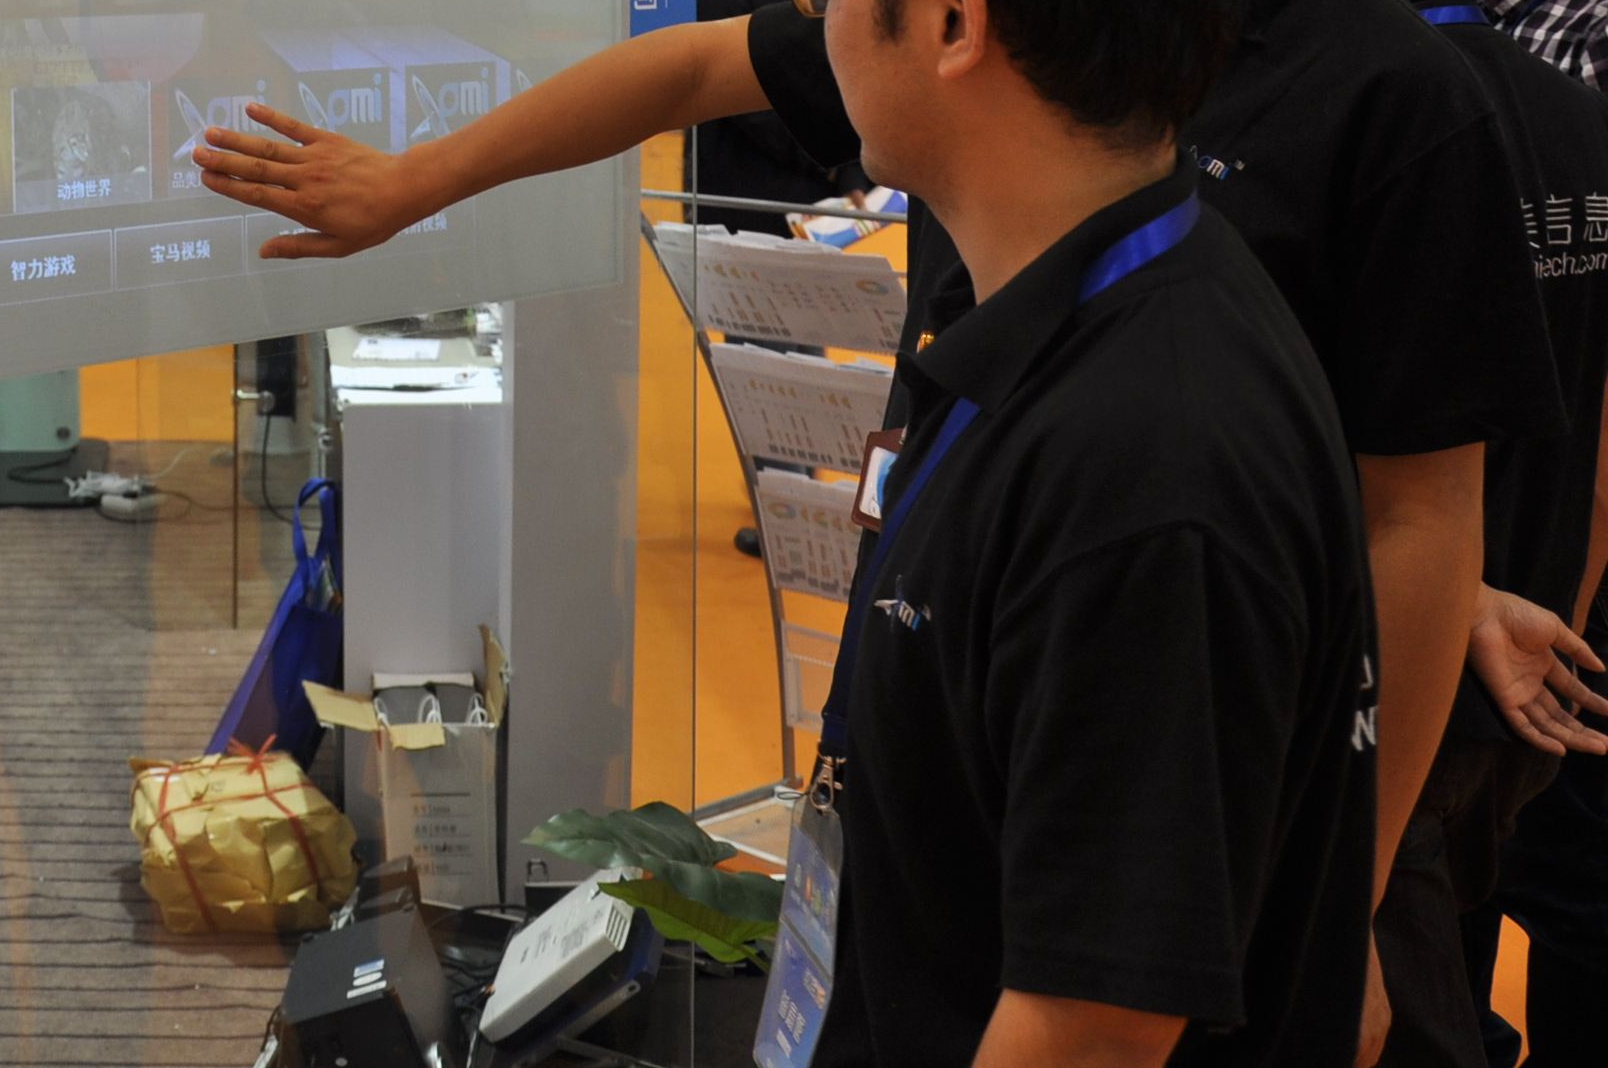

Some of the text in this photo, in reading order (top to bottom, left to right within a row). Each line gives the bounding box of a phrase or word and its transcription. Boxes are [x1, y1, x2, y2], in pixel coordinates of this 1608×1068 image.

[327, 72, 383, 131] pmi
[439, 67, 490, 135] pmi
[56, 178, 112, 201] 动物世界
[150, 239, 212, 264] 宝马视频
[9, 255, 77, 281] 智力游戏
